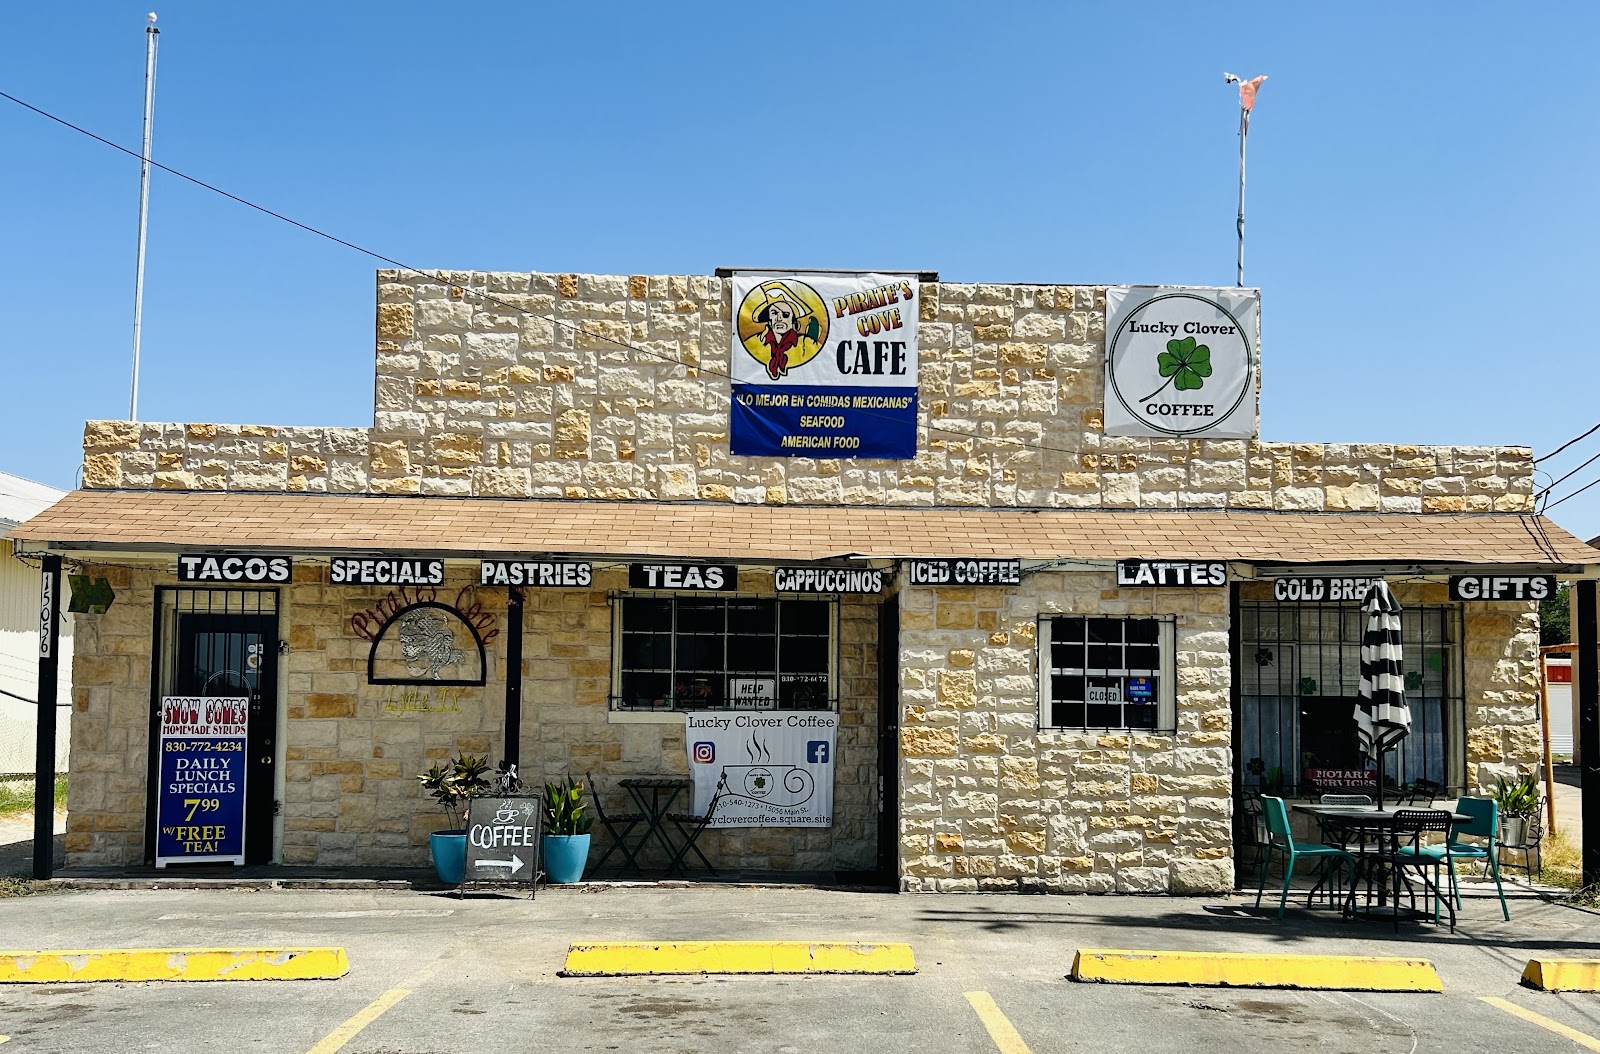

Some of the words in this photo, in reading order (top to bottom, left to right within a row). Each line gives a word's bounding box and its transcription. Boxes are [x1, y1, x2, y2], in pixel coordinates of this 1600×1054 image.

[832, 280, 913, 318] PIRATE'S
[857, 308, 903, 336] COVE
[1129, 321, 1179, 336] Lucky
[1184, 322, 1236, 334] Clover
[836, 340, 907, 375] CAFE
[755, 394, 789, 406] MEJOR
[791, 395, 804, 407] EN
[807, 395, 850, 408] COMIDAS
[1146, 404, 1214, 416] COFFEE
[800, 416, 845, 428] SEAFOOD
[781, 436, 831, 448] AMERICAN
[833, 437, 860, 448] FOOD
[181, 557, 289, 581] TACOS
[331, 560, 443, 583] SPECIALS
[481, 563, 591, 586] PASTRIES
[643, 565, 724, 588] TEAS
[910, 561, 950, 583] ICED
[955, 561, 1019, 583] COFFEE
[1117, 563, 1226, 585] LATTES
[775, 569, 882, 592] CAPPUCCINOS
[1457, 577, 1548, 599] GIFTS
[1275, 579, 1325, 600] COLD
[41, 574, 50, 653] 15056
[455, 585, 500, 645] Cove
[741, 684, 764, 694] HELP
[1089, 690, 1117, 701] CLOSED
[736, 696, 770, 707] WANTED
[164, 698, 201, 724] SNOW
[206, 699, 247, 724] CONES
[163, 725, 211, 735] HOMEMADE
[213, 725, 246, 735] SYRUPS
[689, 717, 731, 730] Lucky
[735, 715, 783, 728] Clover
[787, 715, 835, 728] Coffee
[165, 741, 242, 752] 830-772-4234
[176, 758, 231, 769] DAILY
[175, 770, 231, 781] LUNCH
[1316, 770, 1371, 779] NOTARY
[169, 782, 236, 794] SPECIALS
[710, 814, 832, 826] yclovercoffee.square.site
[176, 825, 226, 840] FREE
[470, 824, 534, 849] COFFEE
[183, 841, 218, 853] TEA!
